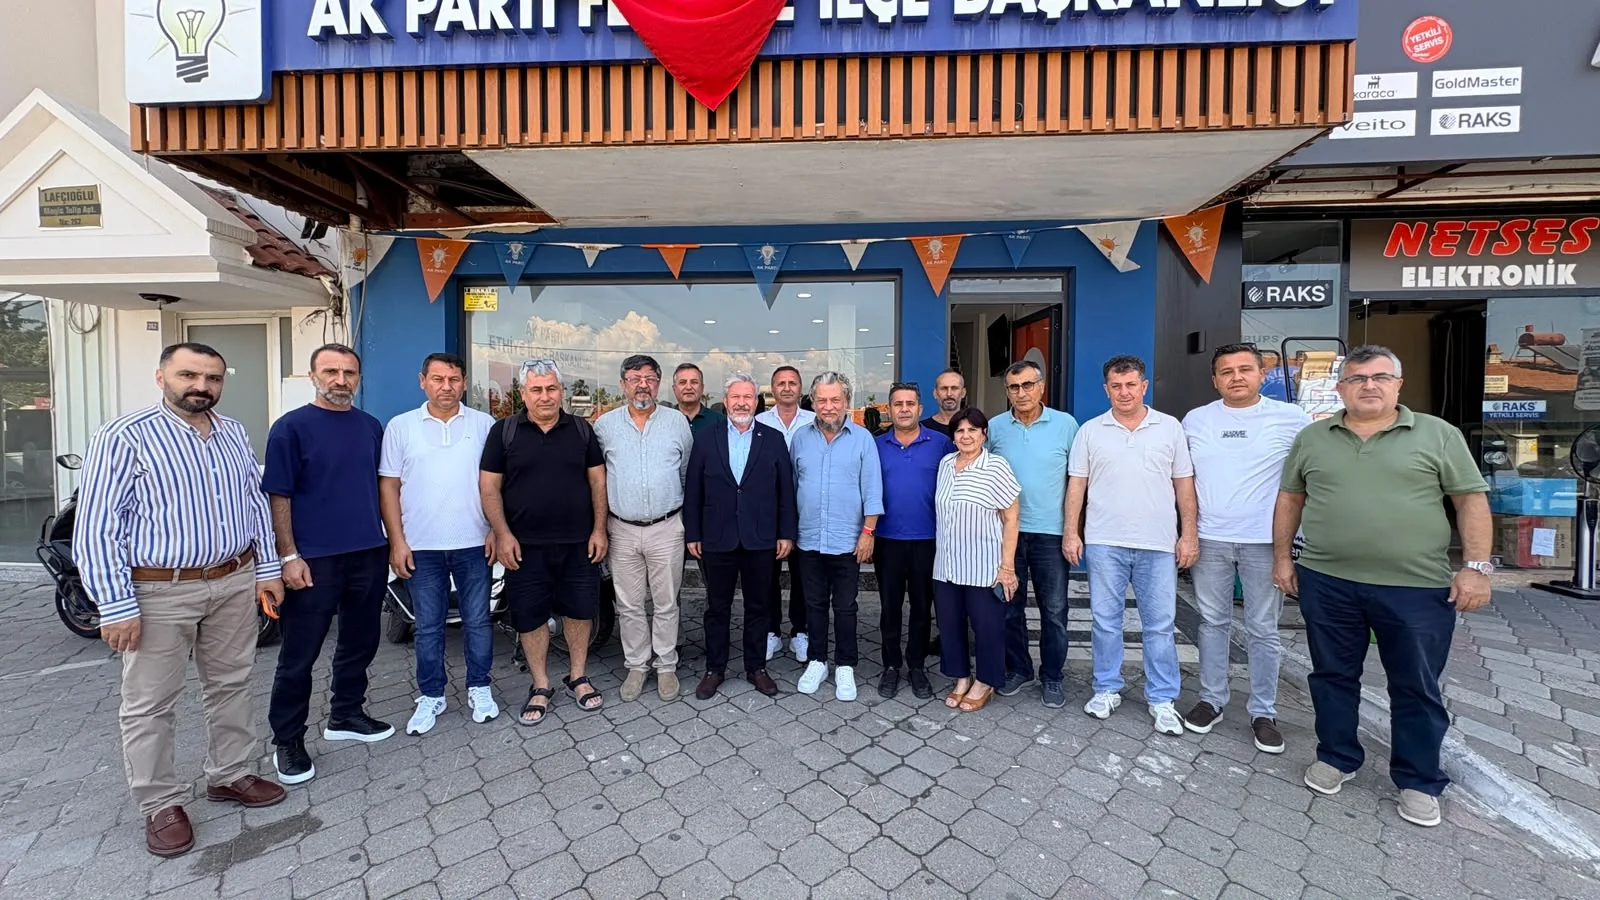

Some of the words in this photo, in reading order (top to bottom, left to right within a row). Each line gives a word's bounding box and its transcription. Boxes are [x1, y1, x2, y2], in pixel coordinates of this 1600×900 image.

[1434, 75, 1519, 90] GoldMaster
[1342, 118, 1406, 131] veito
[1458, 112, 1512, 129] RAKS
[1383, 217, 1600, 257] NETSES
[1402, 258, 1577, 288] ELEKTRONİK
[1266, 285, 1326, 303] RAKS
[1243, 335, 1279, 343] RUPS
[1502, 402, 1536, 411] RAKS
